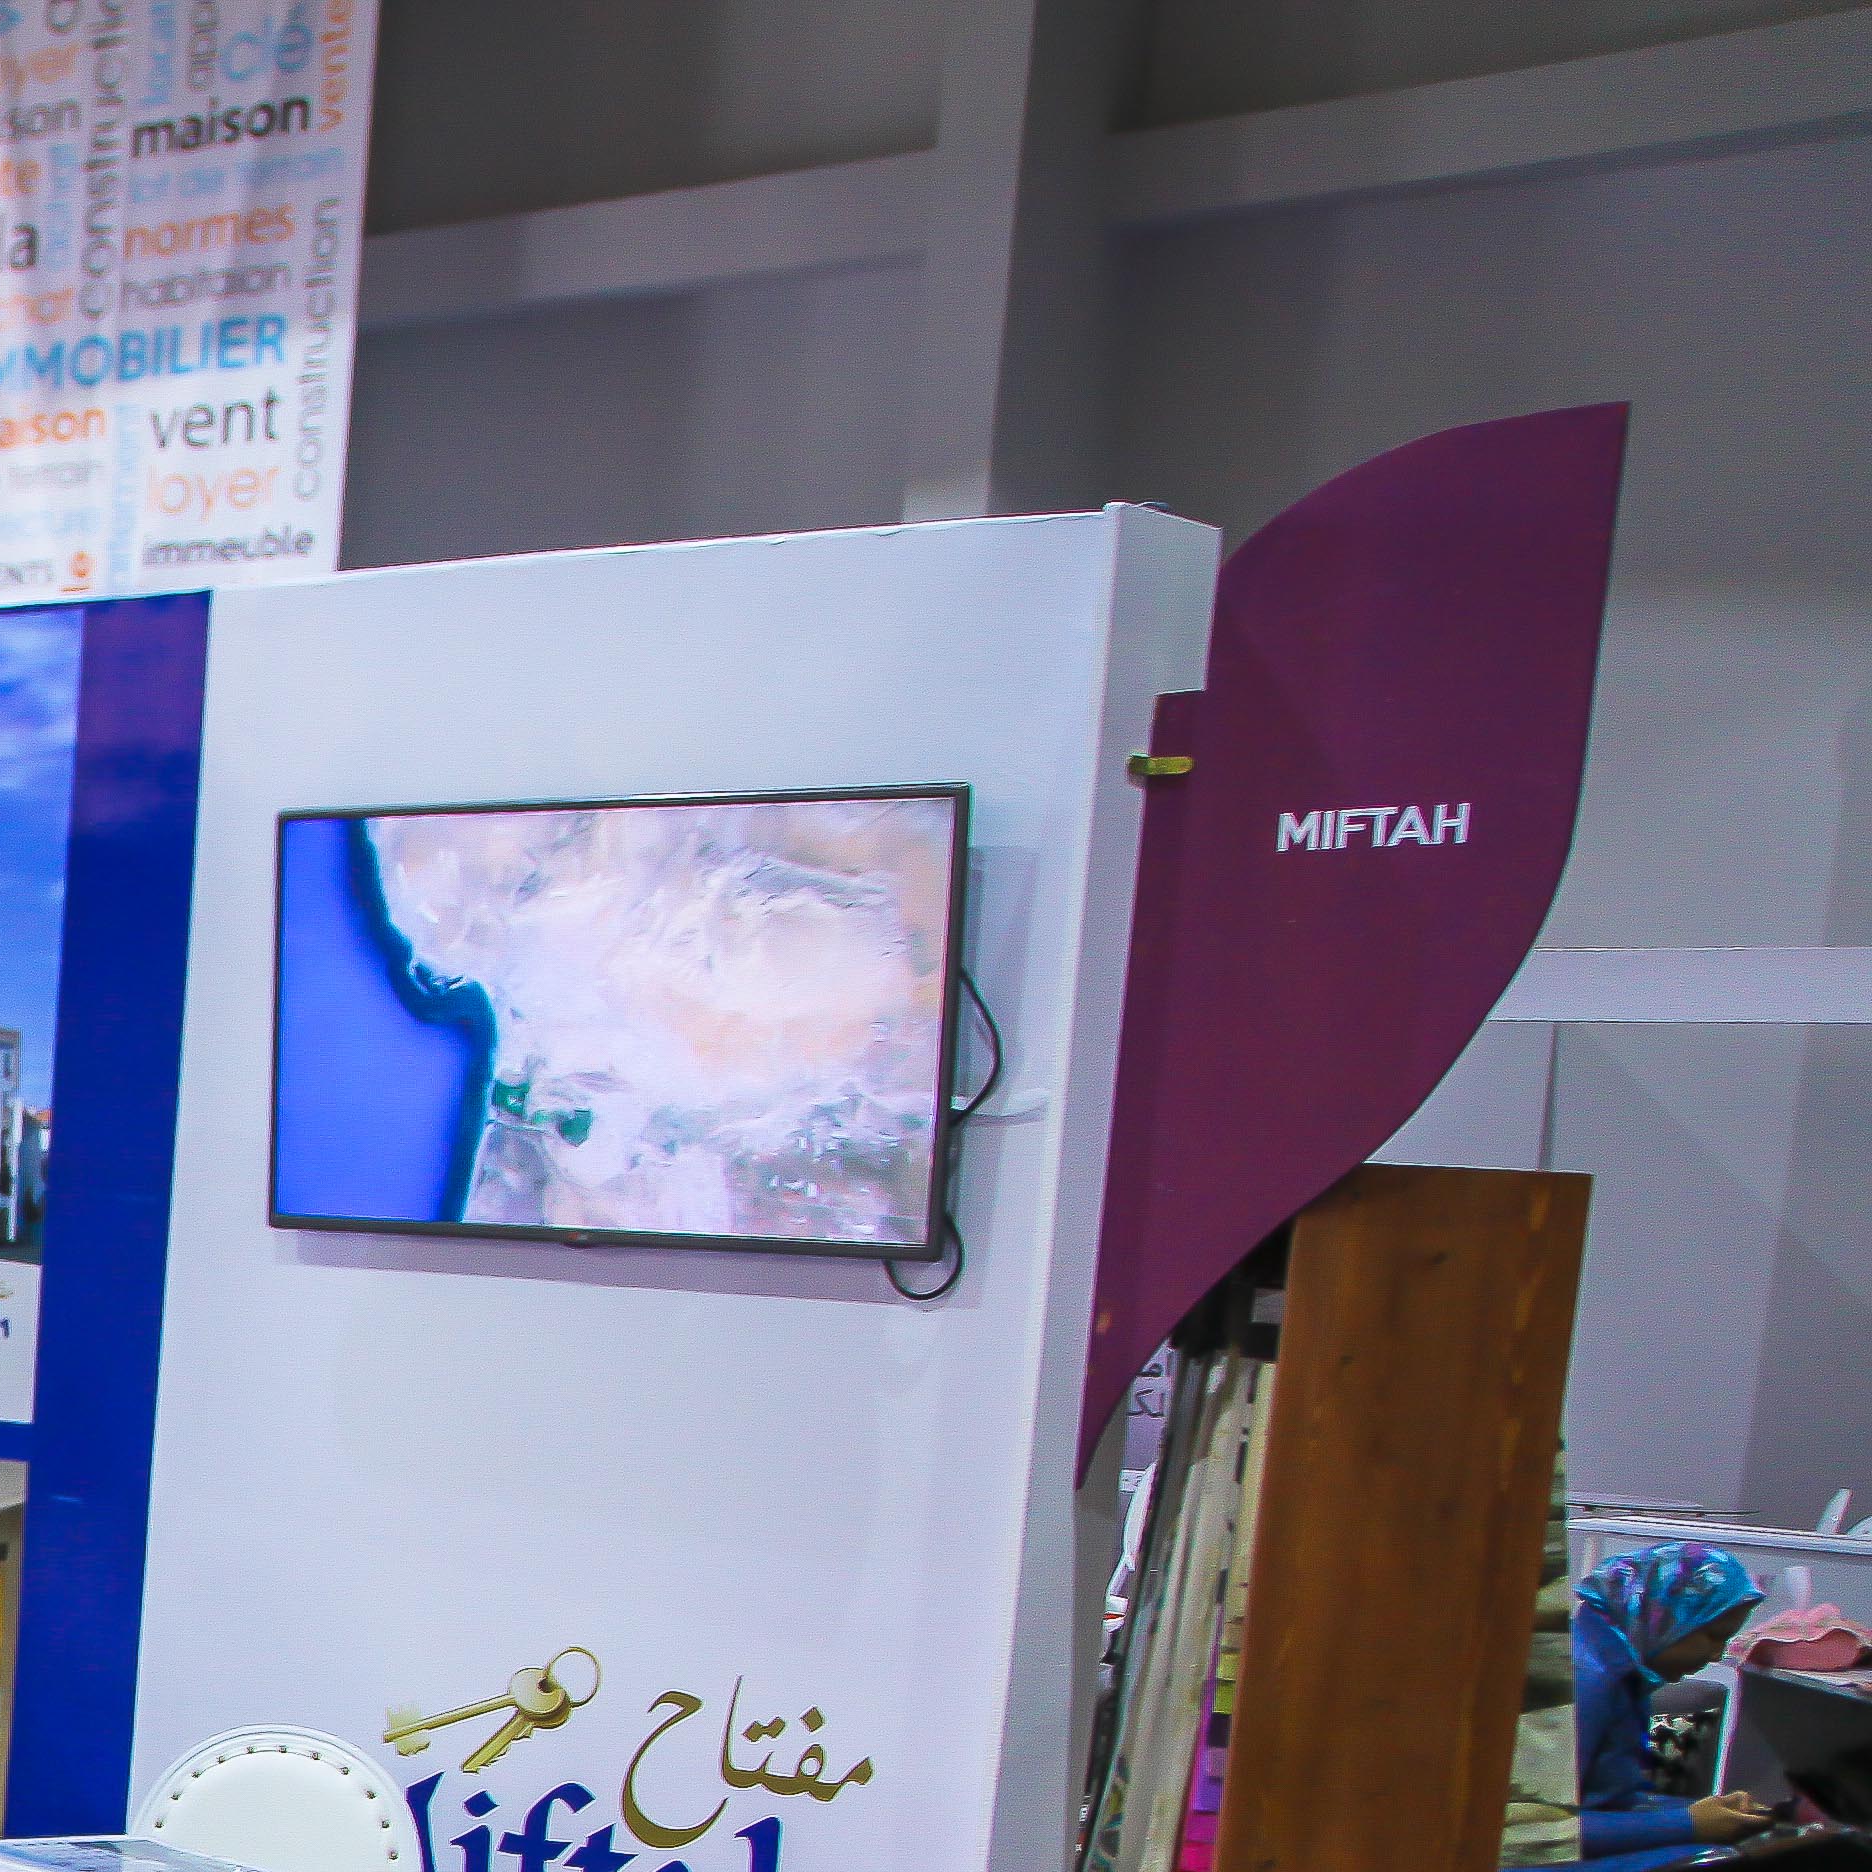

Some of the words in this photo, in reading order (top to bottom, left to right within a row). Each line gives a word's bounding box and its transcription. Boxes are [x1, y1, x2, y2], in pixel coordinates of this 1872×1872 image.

[129, 95, 311, 159] maison
[124, 203, 296, 260] normes
[149, 387, 282, 449] vent
[1274, 802, 1472, 854] MIFTAH
[621, 1674, 874, 1850] مفتاح
